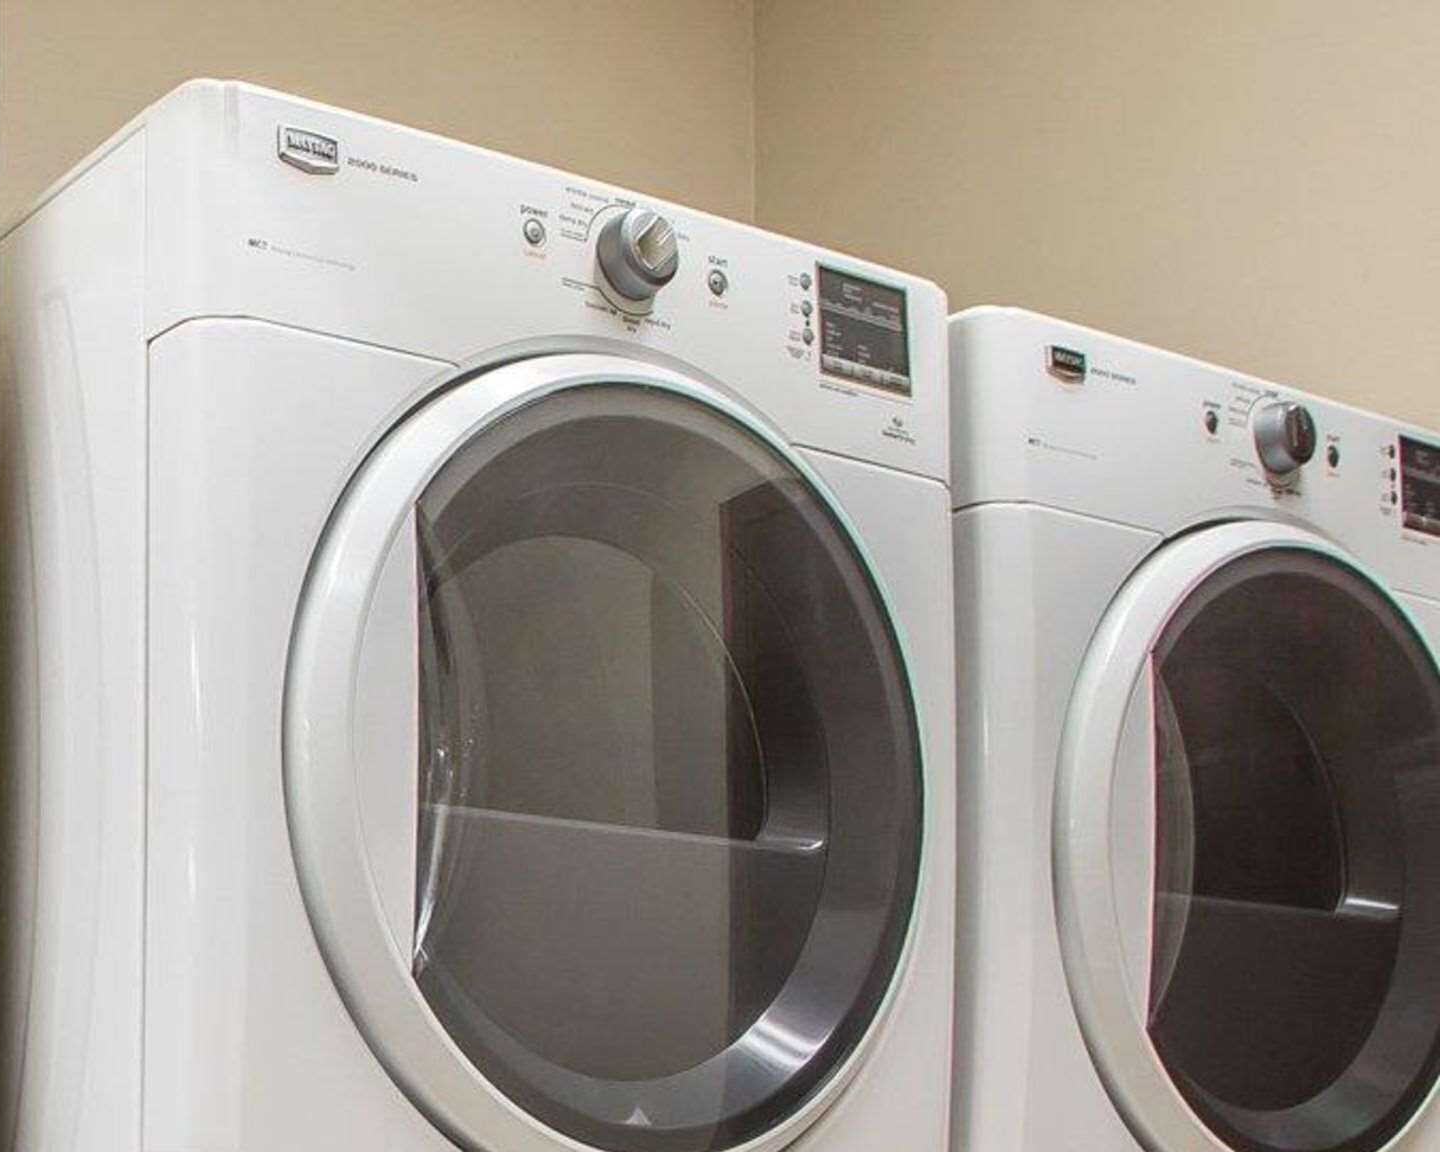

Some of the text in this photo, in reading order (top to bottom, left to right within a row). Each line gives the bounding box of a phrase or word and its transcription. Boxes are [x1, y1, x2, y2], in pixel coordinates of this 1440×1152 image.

[286, 131, 419, 182] MAYTAG 2000 SERIES
[519, 204, 548, 218] power
